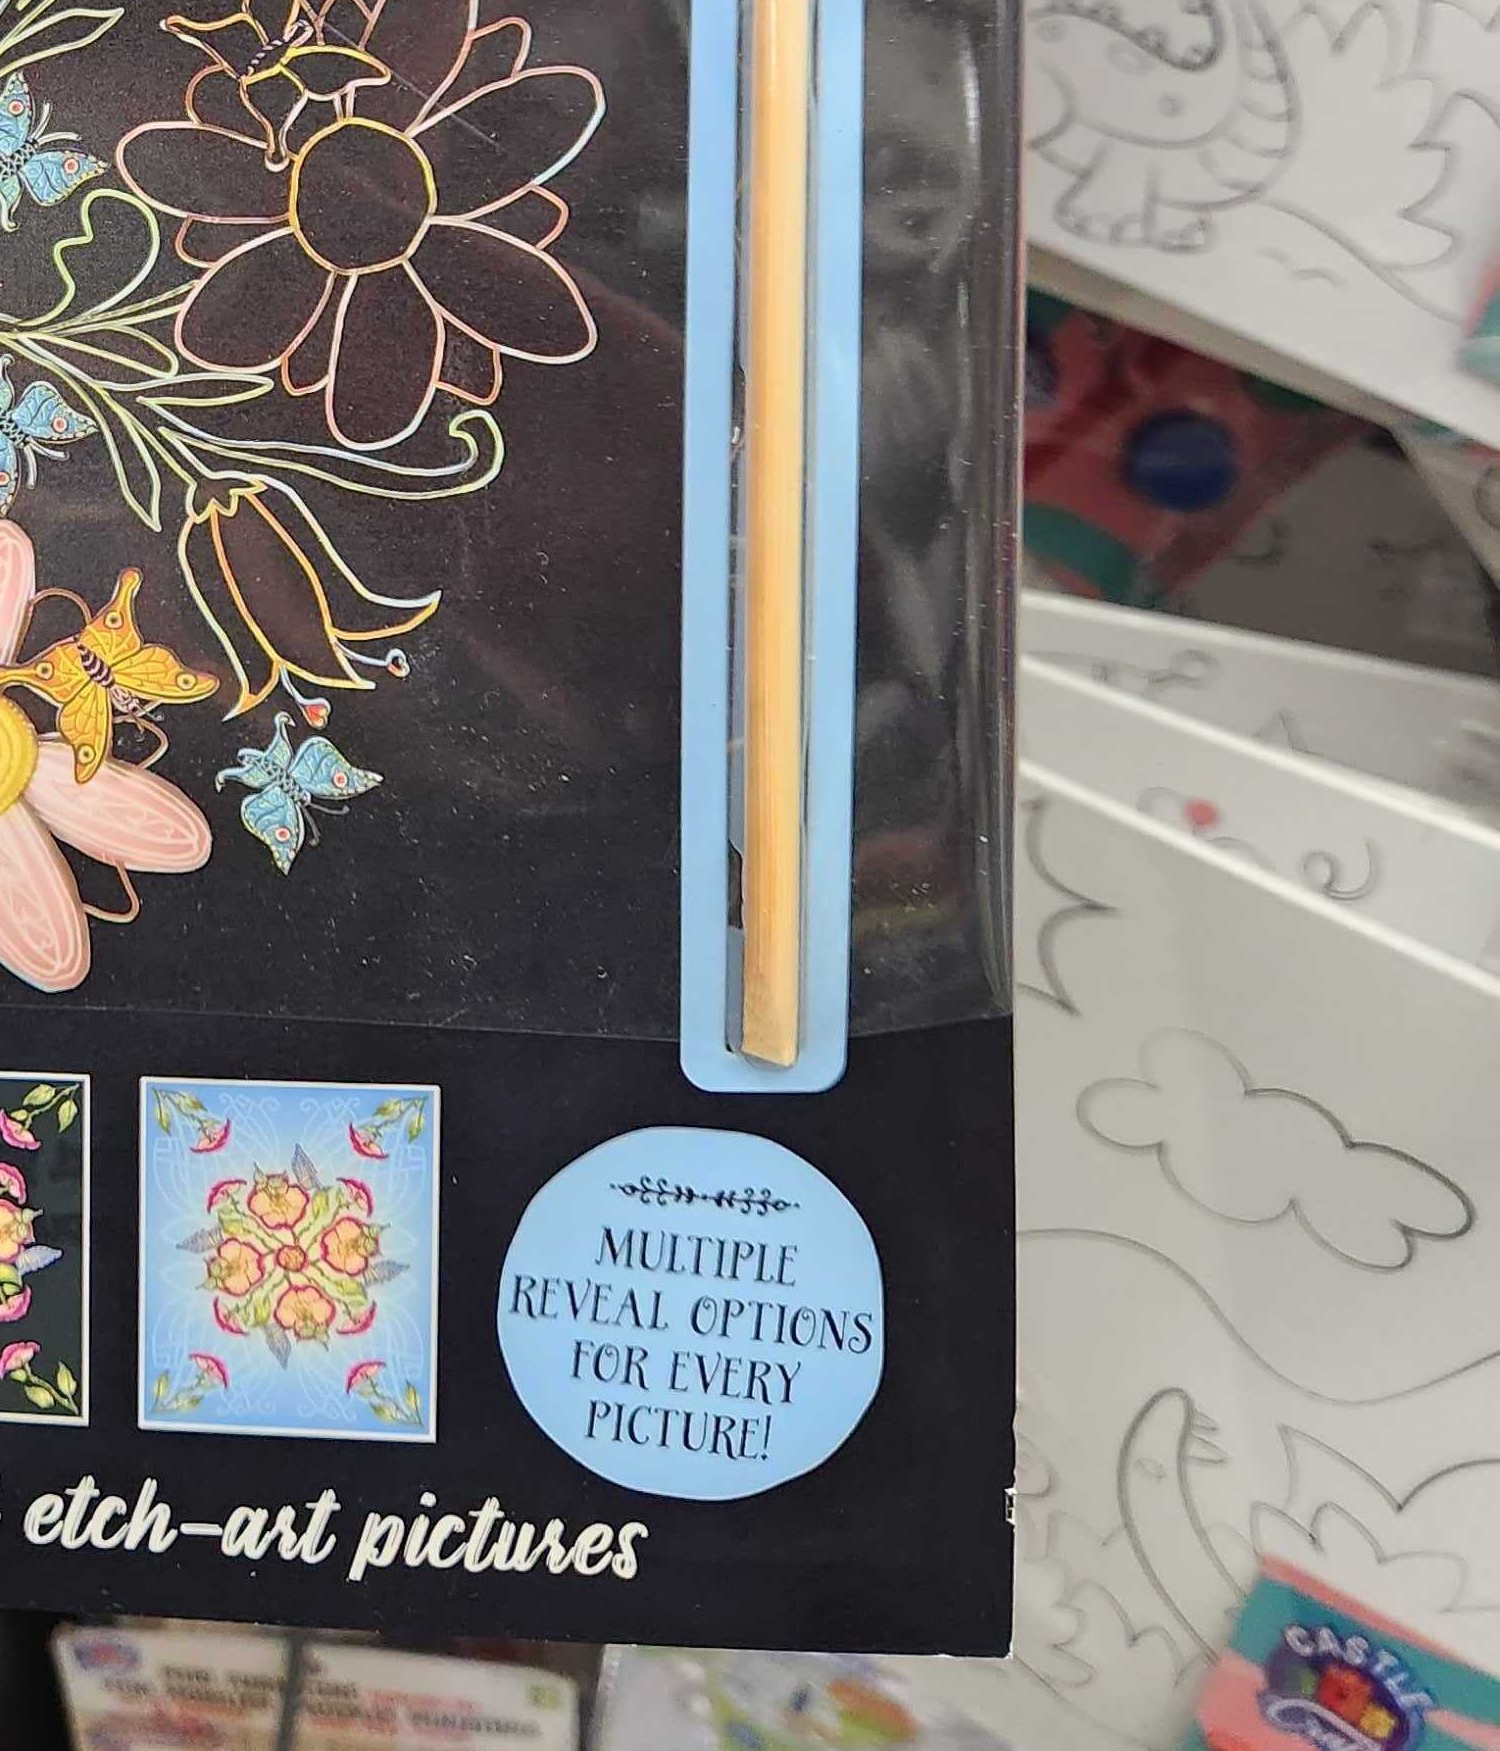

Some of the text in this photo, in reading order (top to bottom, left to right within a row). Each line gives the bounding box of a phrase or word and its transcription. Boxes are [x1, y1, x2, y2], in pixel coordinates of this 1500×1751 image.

[594, 1225, 799, 1288] MULTIPLE
[507, 1274, 873, 1356] REVEAL OPTIONS
[570, 1339, 802, 1406] FOR EVERY
[584, 1399, 772, 1462] PICTURE!
[22, 1474, 342, 1565] etch-art
[346, 1491, 650, 1582] pictures
